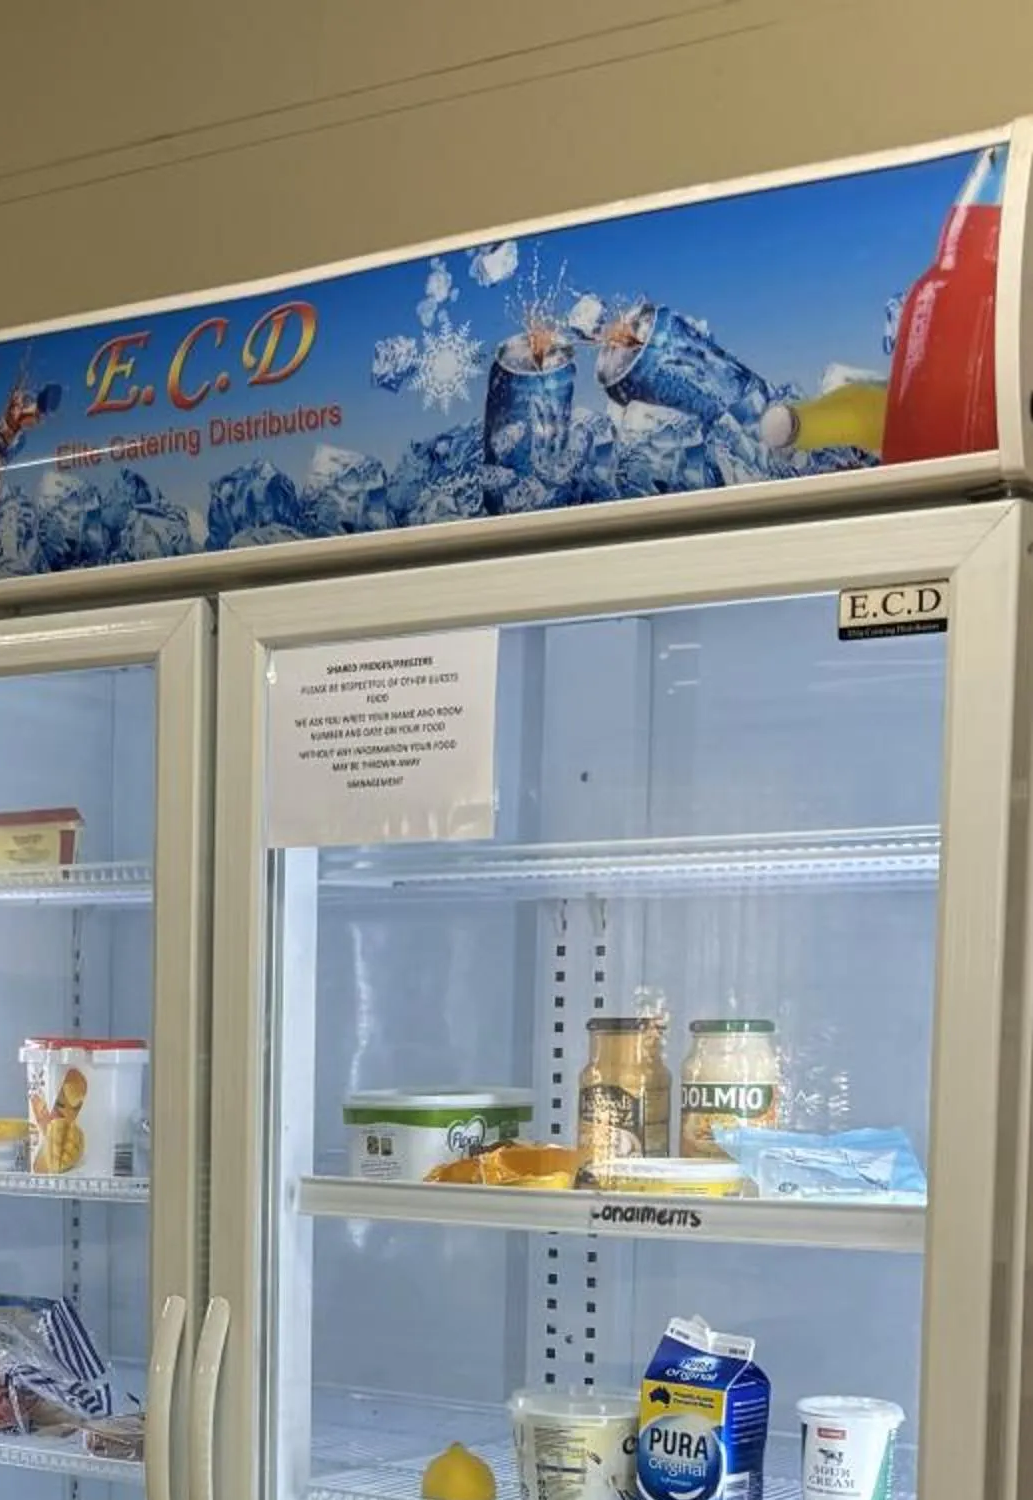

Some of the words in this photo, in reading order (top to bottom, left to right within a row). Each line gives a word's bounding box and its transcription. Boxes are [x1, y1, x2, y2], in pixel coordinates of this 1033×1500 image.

[86, 300, 317, 417] E.C.D
[56, 444, 102, 471] Elite
[110, 427, 201, 459] Catering
[210, 403, 342, 445] Distributors
[849, 587, 942, 619] E.C.D
[649, 1427, 709, 1461] PURA
